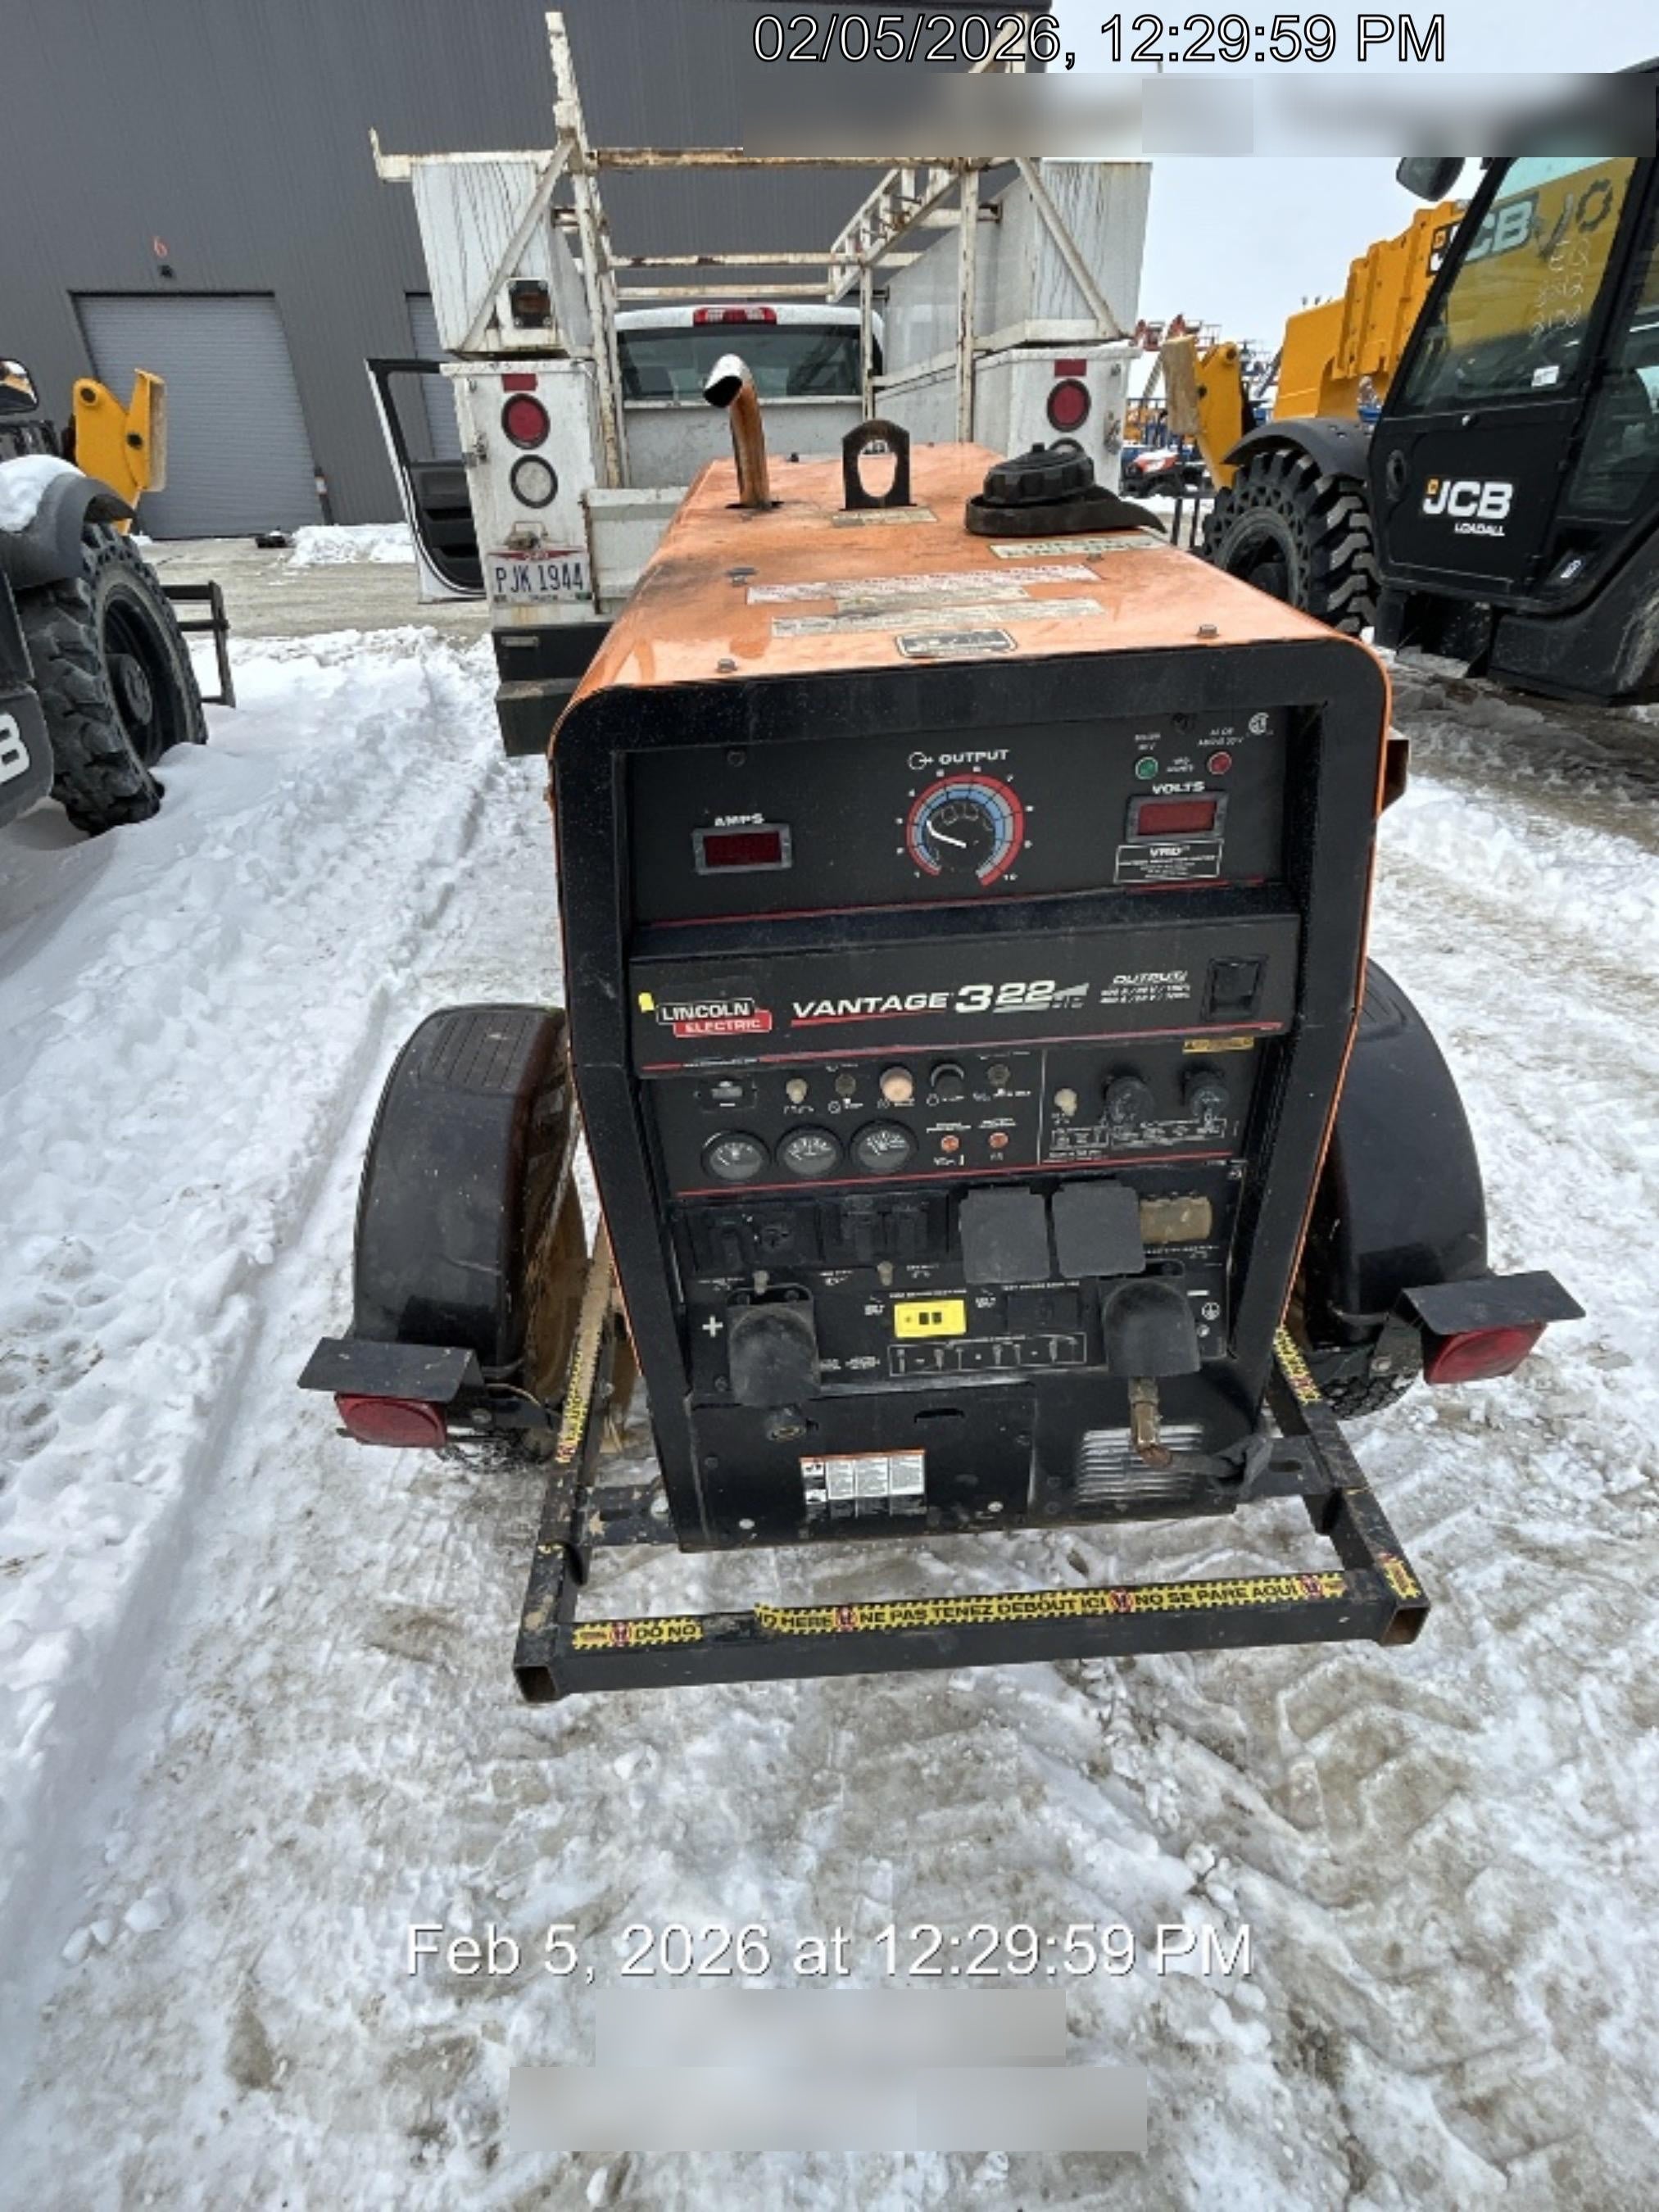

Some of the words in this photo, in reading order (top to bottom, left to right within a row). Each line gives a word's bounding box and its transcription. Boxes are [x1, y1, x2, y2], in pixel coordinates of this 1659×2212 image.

[1422, 478, 1513, 519] JCB
[1454, 522, 1505, 537] LOADALL
[495, 564, 531, 592] PJK
[537, 563, 583, 591] 1944
[938, 749, 1009, 764] OUTPUT
[1153, 781, 1204, 794] VOLTS
[714, 813, 764, 827] AMPS
[792, 992, 949, 1018] VANTAGE
[955, 980, 1055, 1013] 322
[662, 1002, 750, 1021] LINCOLN
[685, 1018, 760, 1033] ELECTRIC
[1135, 1592, 1163, 1606] NO
[1168, 1592, 1193, 1603] SE
[1197, 1588, 1247, 1602] PARE
[861, 1611, 885, 1622] NE
[891, 1608, 927, 1620] PAS
[933, 1604, 993, 1618] TENEZ
[1081, 1597, 1106, 1607] ICI
[782, 1616, 832, 1627] HERE
[636, 1626, 664, 1639] DO
